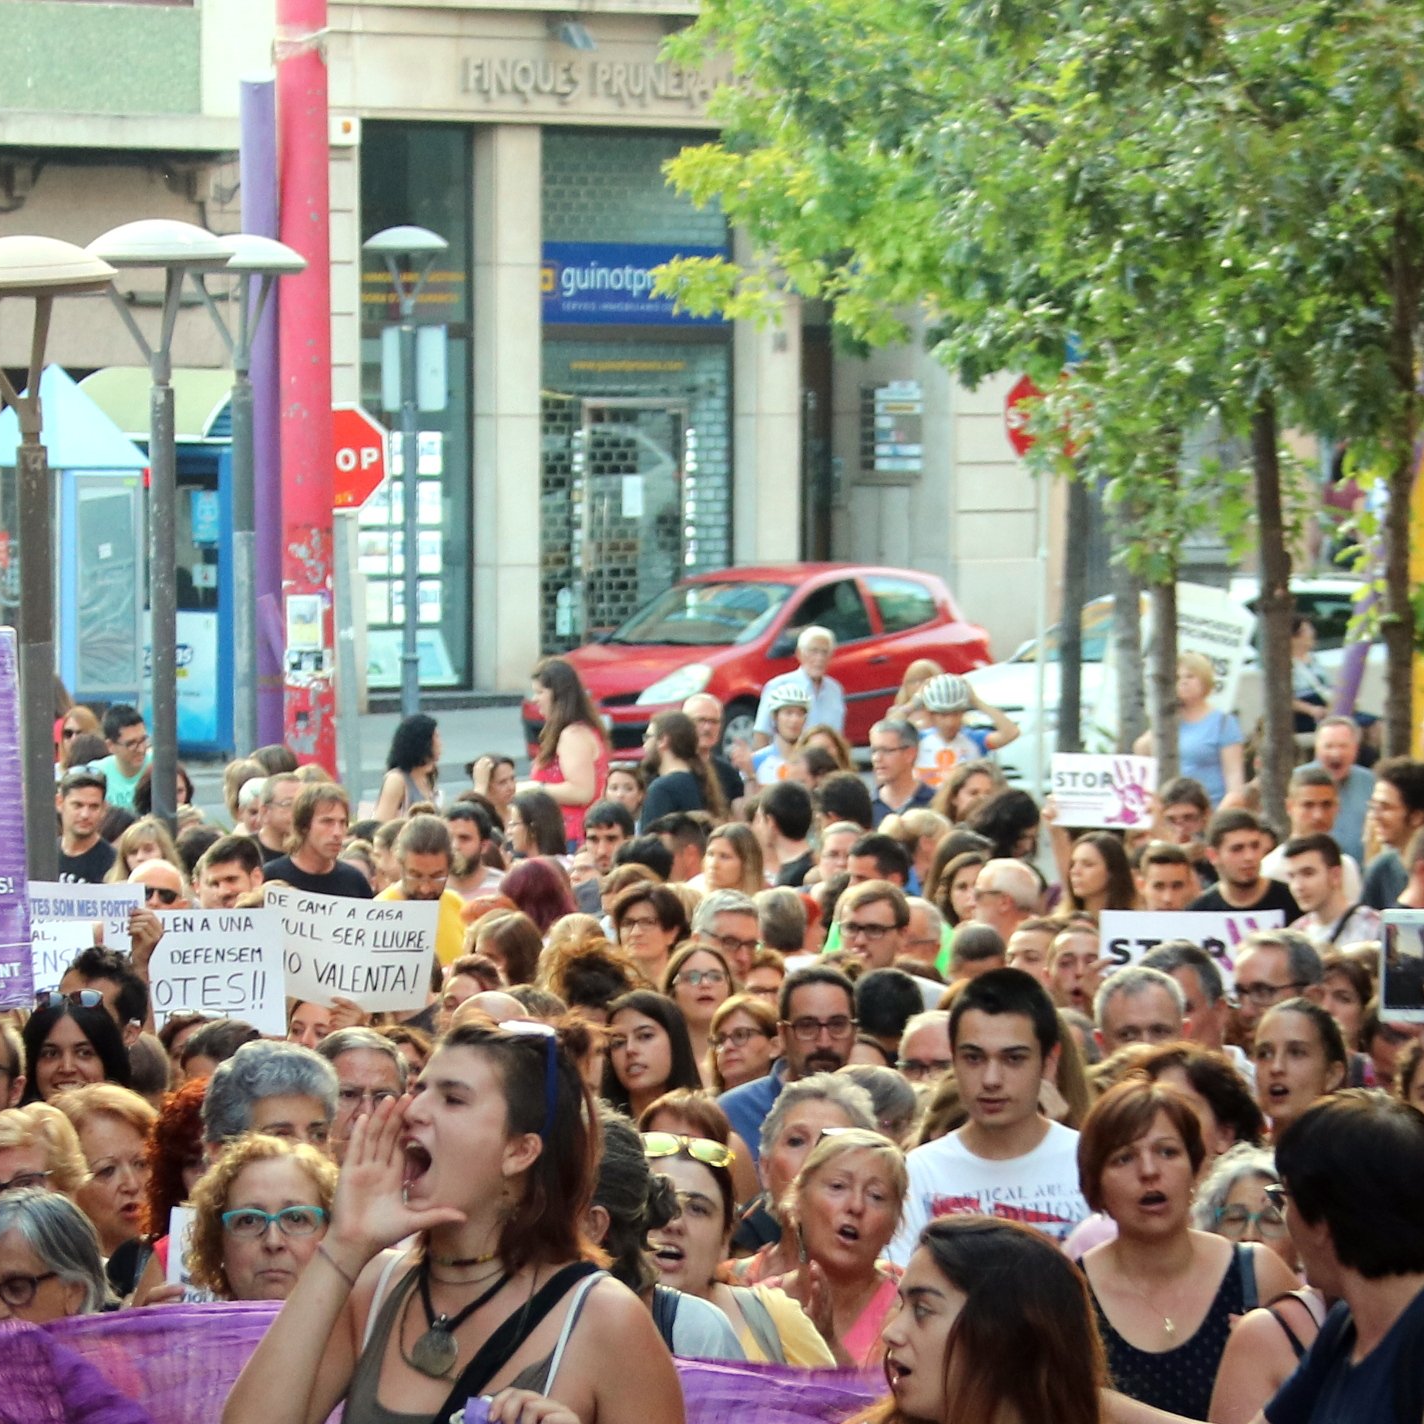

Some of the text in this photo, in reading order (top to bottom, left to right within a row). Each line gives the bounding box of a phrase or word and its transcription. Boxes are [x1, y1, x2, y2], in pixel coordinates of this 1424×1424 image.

[465, 58, 578, 97] FINQUES
[335, 447, 380, 472] OP
[1056, 771, 1113, 788] STOP
[53, 899, 75, 917] SOM
[77, 899, 98, 917] MES
[267, 891, 404, 922] DE CAMÍ A CASA
[31, 930, 58, 942] AL,
[161, 916, 194, 933] LEN
[200, 919, 211, 932] A
[219, 916, 254, 932] UNA
[281, 917, 432, 952] ULL SER LLIURE.
[170, 946, 264, 965] DEFENSEM
[1109, 937, 1226, 965] STP
[155, 970, 266, 1009] OTES!!
[313, 958, 421, 995] VALENTA!
